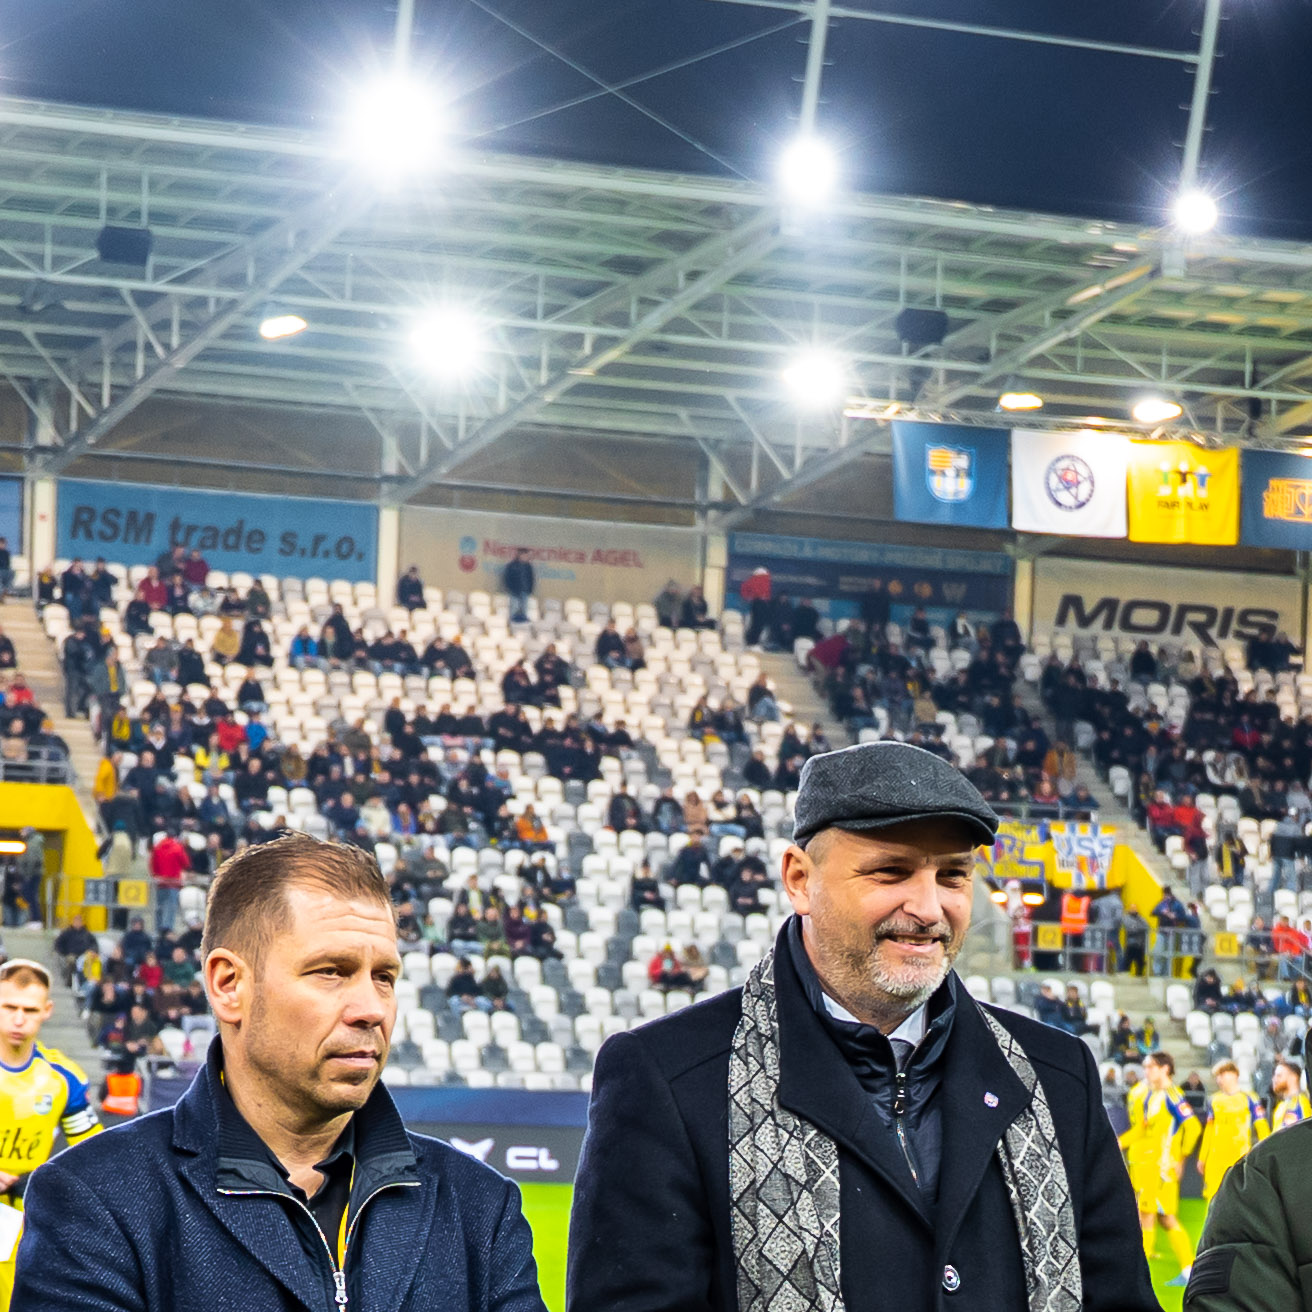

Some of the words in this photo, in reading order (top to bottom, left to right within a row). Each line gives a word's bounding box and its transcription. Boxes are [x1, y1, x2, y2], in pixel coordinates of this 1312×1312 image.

[70, 505, 157, 545] RSM
[169, 514, 267, 552] trade
[277, 527, 365, 562] s.r.o.
[1054, 594, 1280, 649] MORIS
